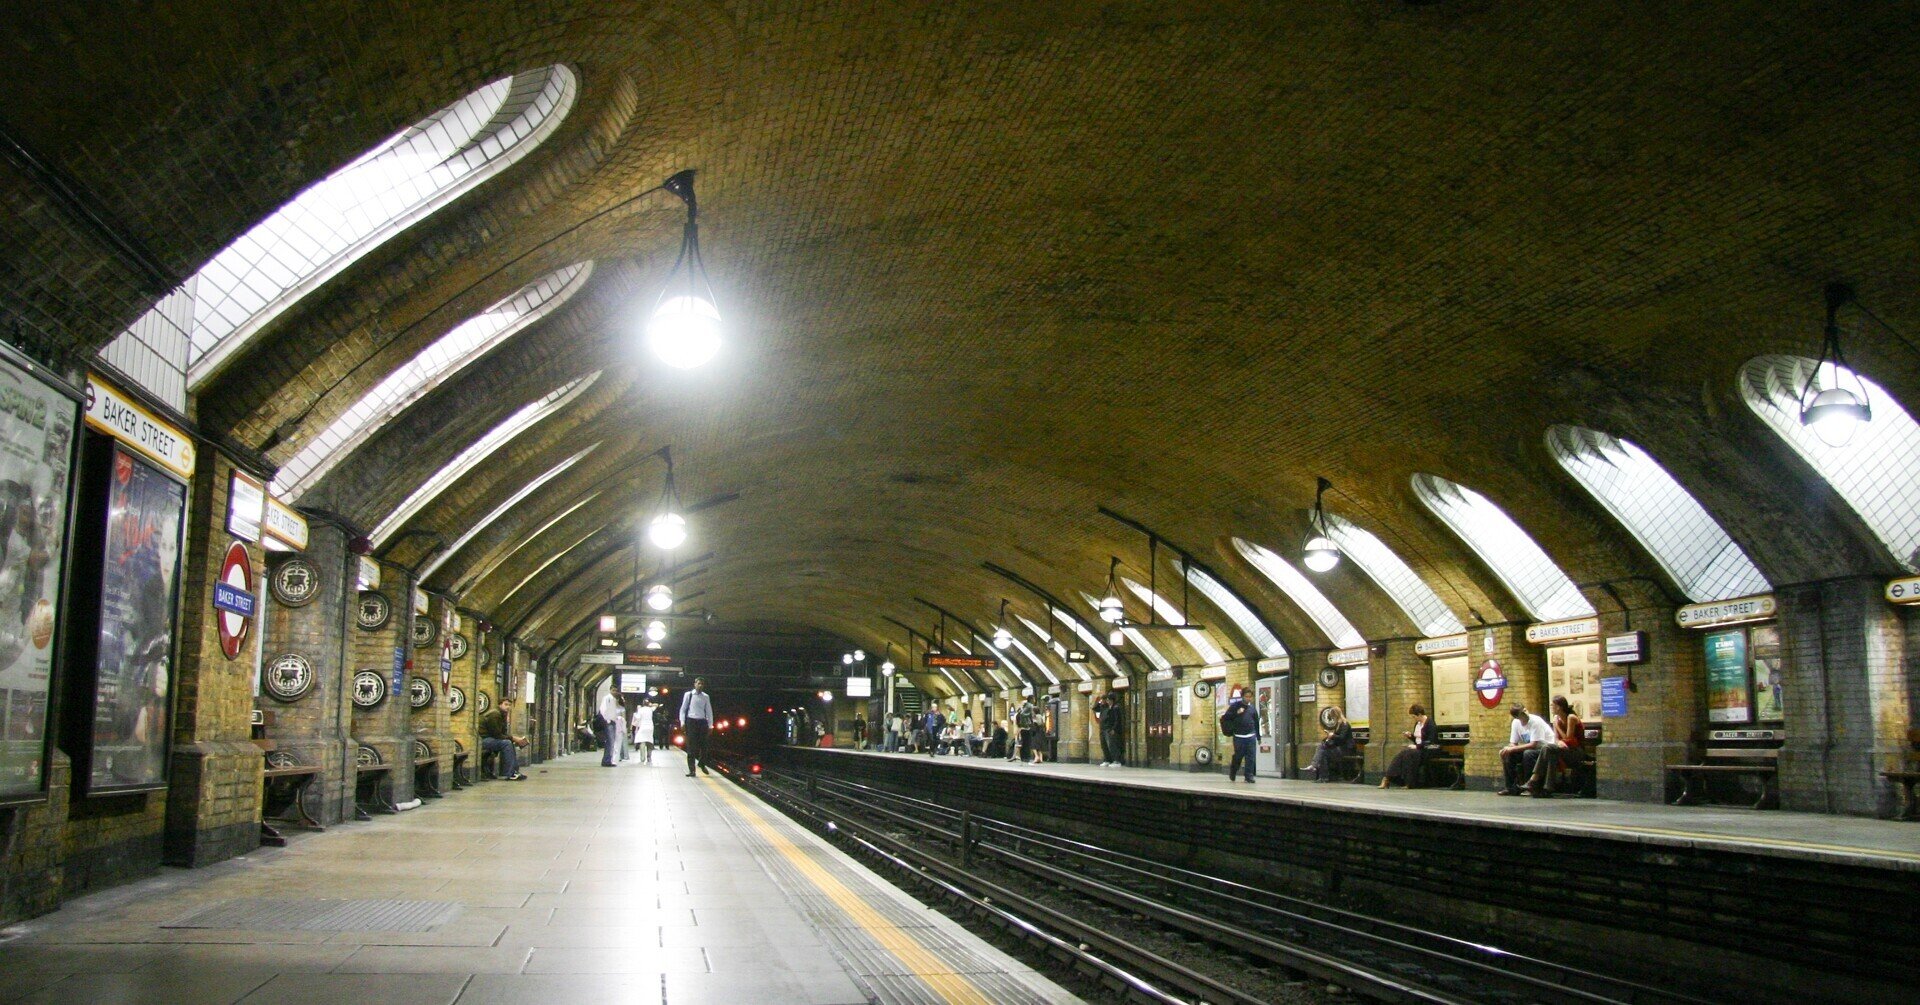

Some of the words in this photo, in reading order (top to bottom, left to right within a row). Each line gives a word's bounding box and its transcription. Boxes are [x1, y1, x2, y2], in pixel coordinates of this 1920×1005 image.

[103, 396, 137, 437] BAKER
[141, 421, 176, 459] STREET
[281, 513, 299, 538] STREET
[218, 589, 234, 606] BAKER
[235, 593, 252, 610] STREET
[1693, 607, 1719, 620] BAKER
[1723, 601, 1754, 616] STREET
[1540, 627, 1559, 638] BAKER
[1562, 623, 1585, 635] STREET
[1441, 638, 1459, 648] STREET
